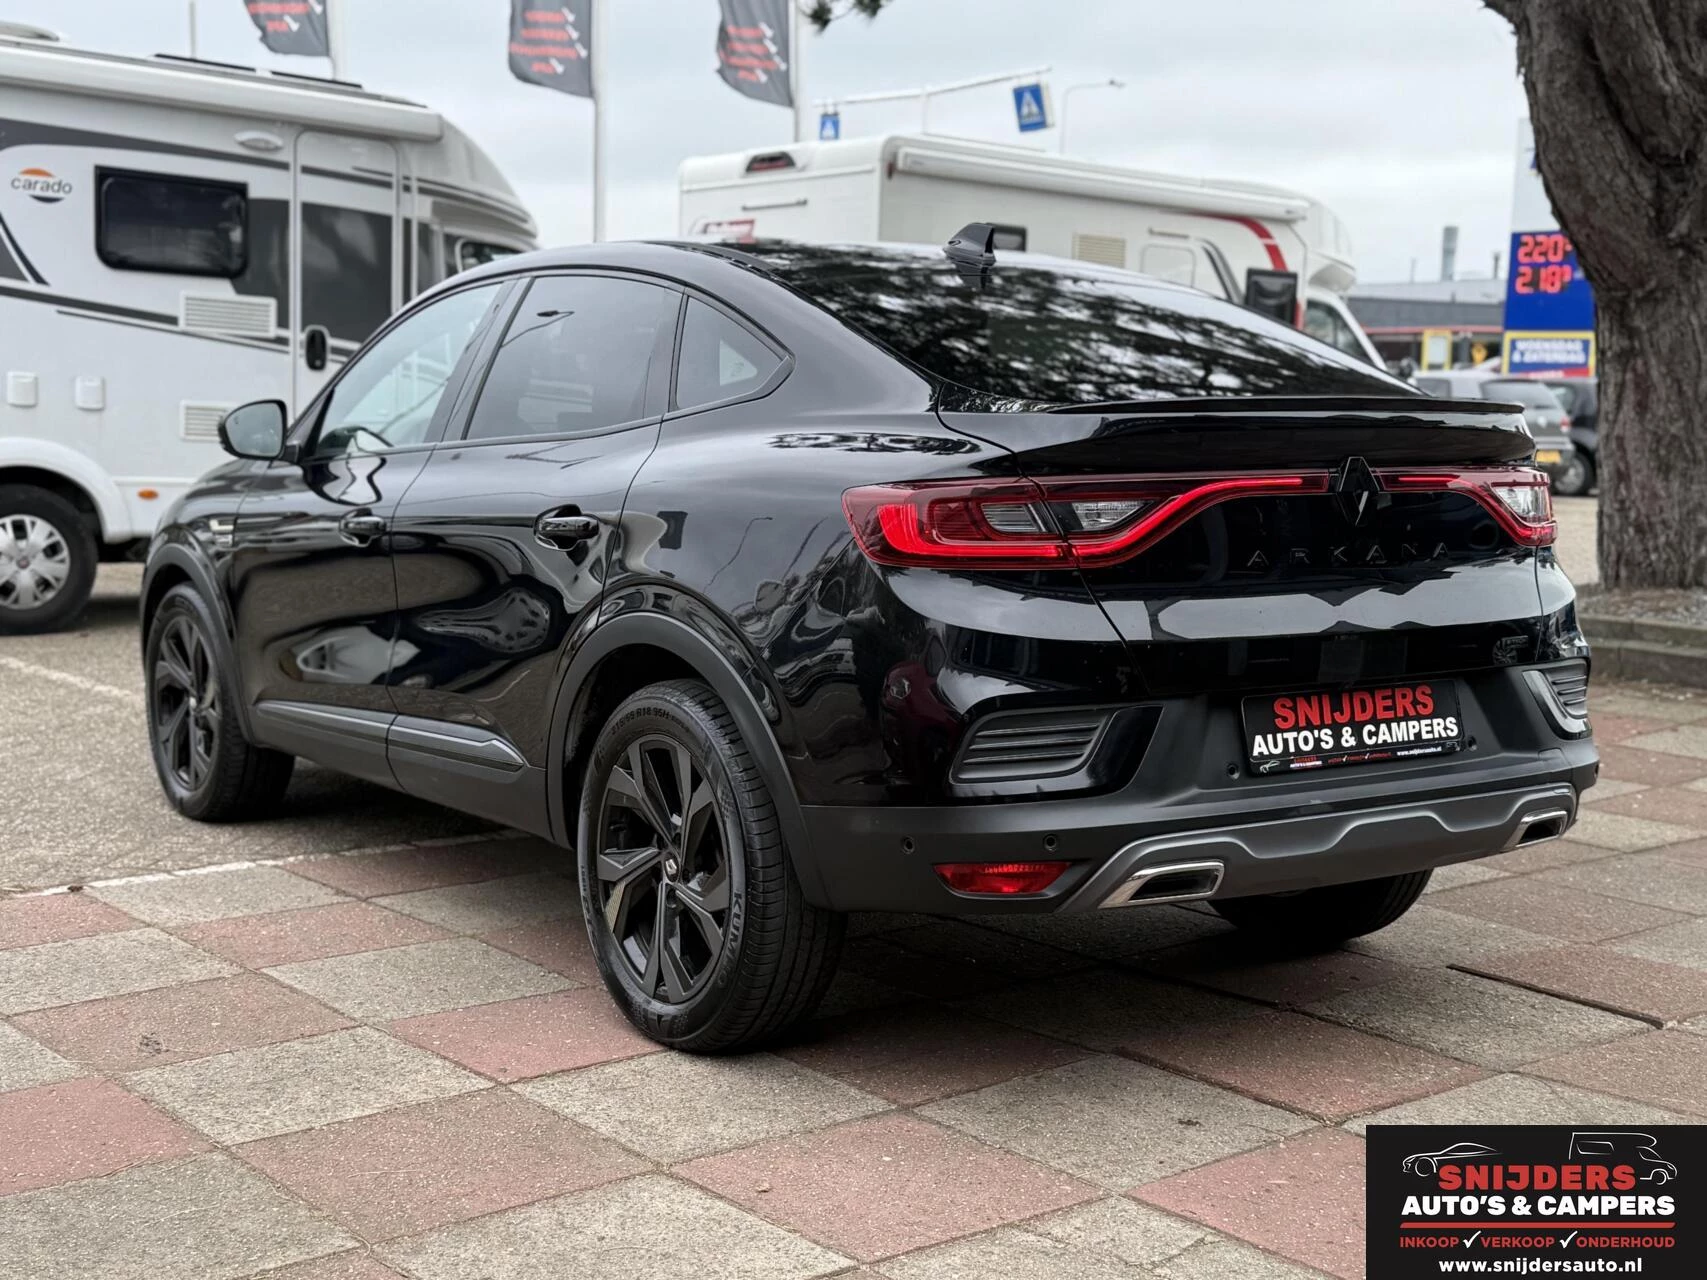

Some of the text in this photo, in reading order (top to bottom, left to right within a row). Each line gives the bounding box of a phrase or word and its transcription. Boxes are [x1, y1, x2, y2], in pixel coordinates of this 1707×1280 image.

[11, 178, 73, 194] carado
[1246, 541, 1449, 568] ARKANA
[1273, 685, 1434, 729] SNIJDERS
[1253, 716, 1459, 756] AUTO'S & CAMPERS
